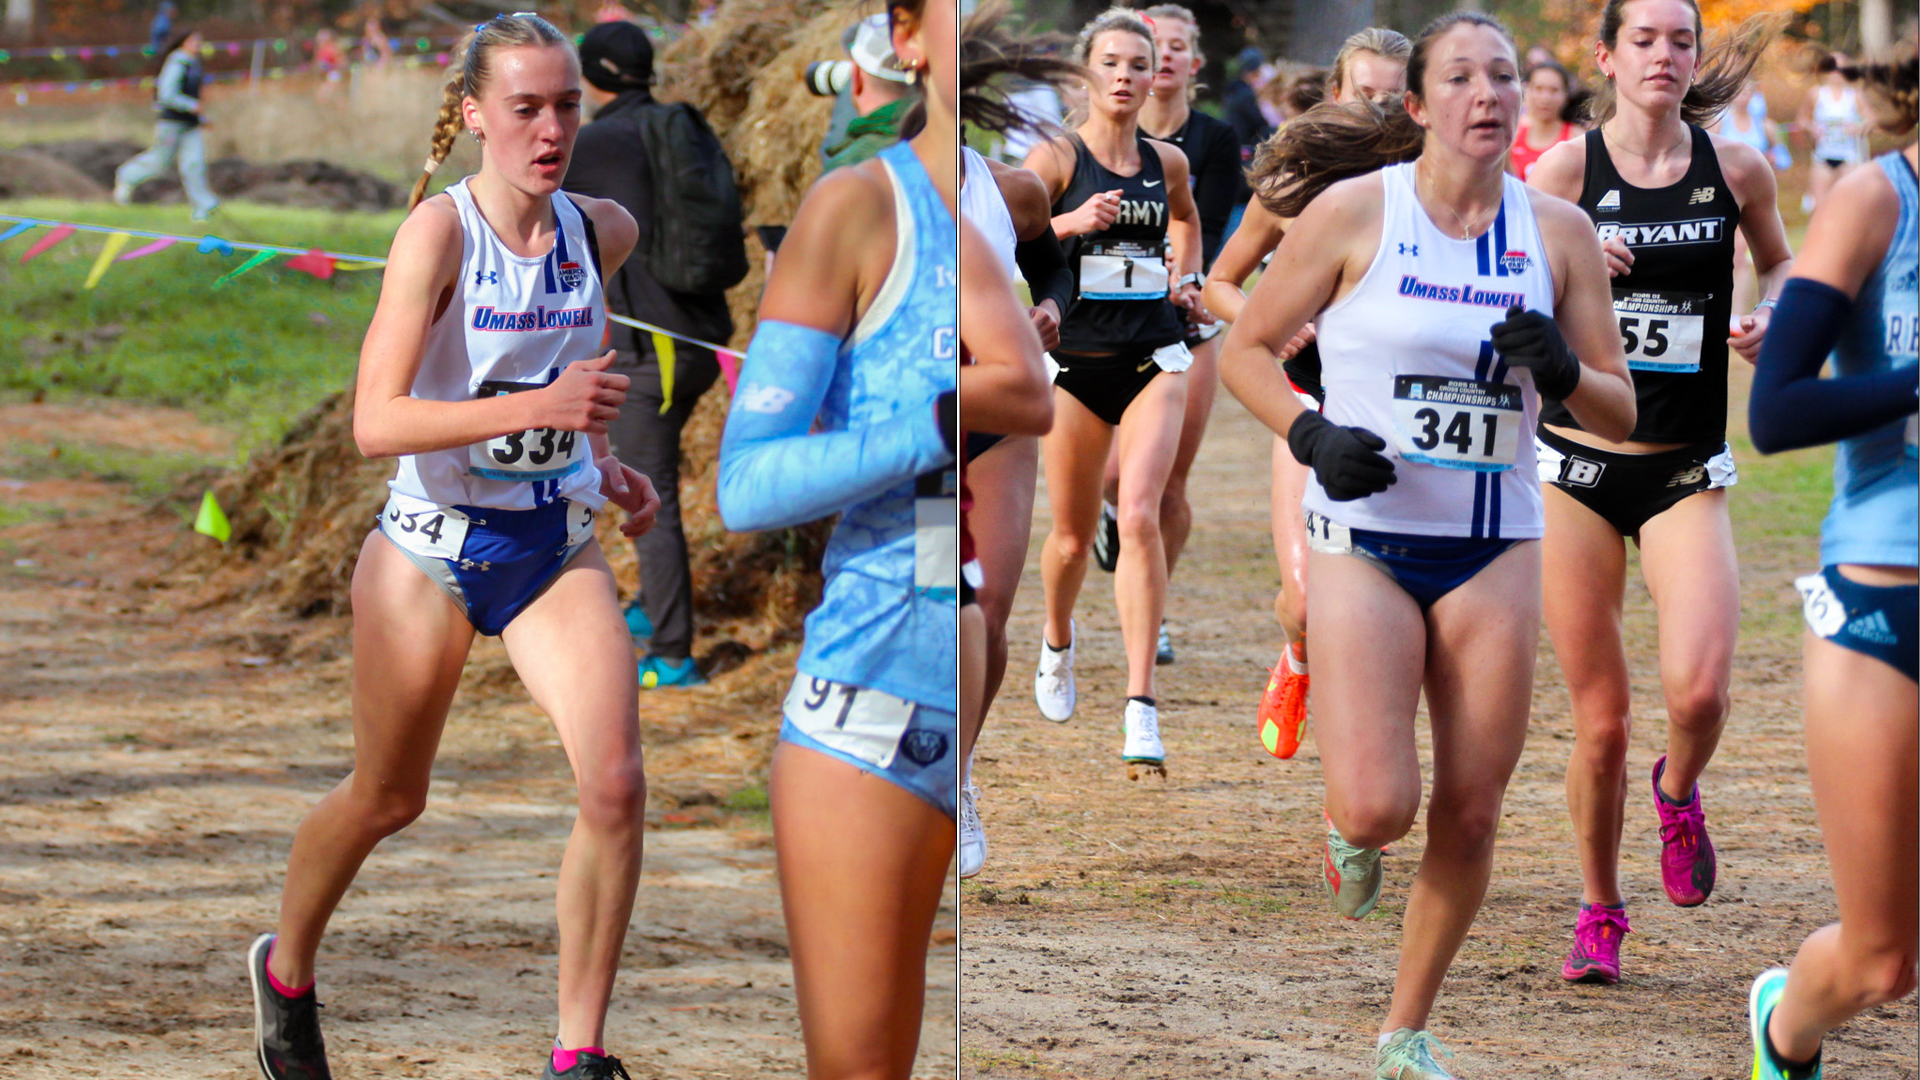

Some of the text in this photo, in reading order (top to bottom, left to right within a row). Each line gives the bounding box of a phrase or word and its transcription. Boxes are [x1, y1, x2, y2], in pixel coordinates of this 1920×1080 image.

[1115, 199, 1164, 226] RMY
[1597, 221, 1718, 244] BRYANT
[1613, 300, 1678, 314] CHAMPIONSHIPS
[1426, 390, 1497, 407] CHAMPIONSHIPS
[1411, 407, 1498, 457] 341
[492, 427, 575, 465] 334
